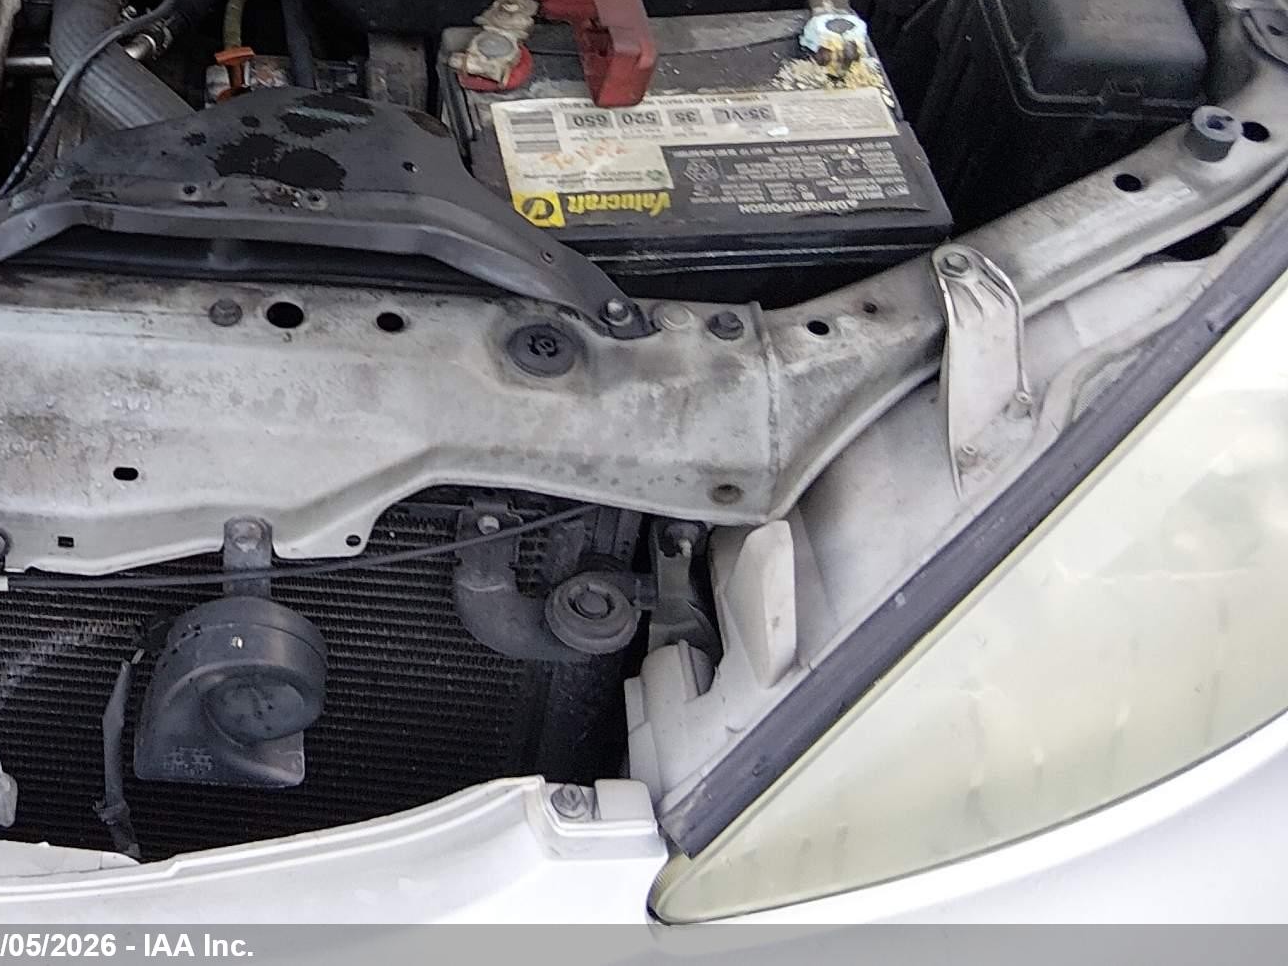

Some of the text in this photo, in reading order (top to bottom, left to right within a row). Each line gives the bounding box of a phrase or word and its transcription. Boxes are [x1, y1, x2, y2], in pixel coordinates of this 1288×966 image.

[573, 113, 608, 127] 650
[621, 112, 657, 125] 520
[674, 111, 697, 123] 35
